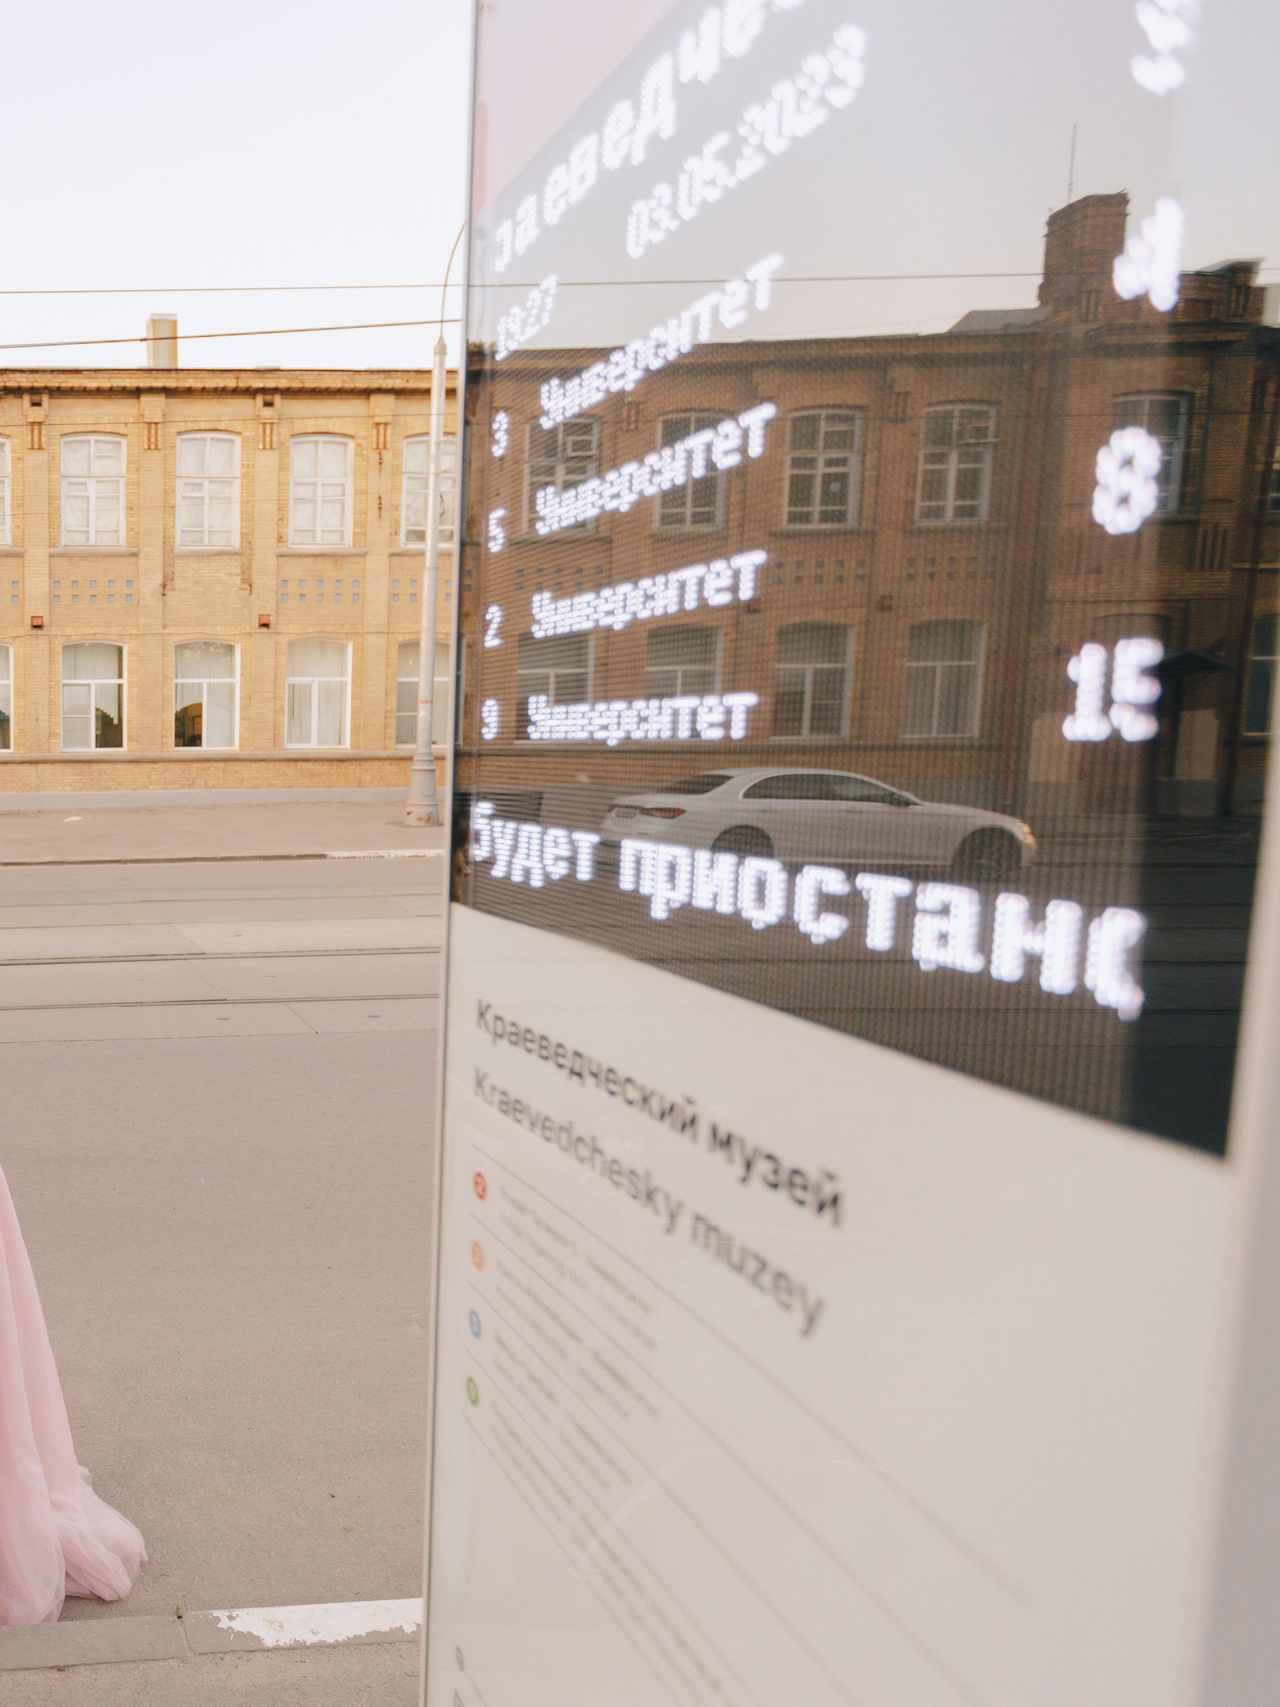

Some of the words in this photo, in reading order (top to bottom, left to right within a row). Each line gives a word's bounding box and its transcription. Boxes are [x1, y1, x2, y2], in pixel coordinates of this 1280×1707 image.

[626, 21, 869, 259] 03.05.2023
[538, 252, 785, 431] Университет
[483, 604, 503, 648] 2
[530, 550, 769, 639] Университет
[1092, 425, 1163, 536] 8
[488, 507, 507, 553] 5
[535, 402, 777, 535] Университет
[481, 698, 500, 740] 9
[526, 692, 759, 747] Университет
[1062, 636, 1166, 743] 15
[472, 1067, 684, 1236] Kraevedchesky
[688, 1209, 825, 1339] muzey
[475, 997, 699, 1142] Краеведческий
[708, 1121, 842, 1228] музей
